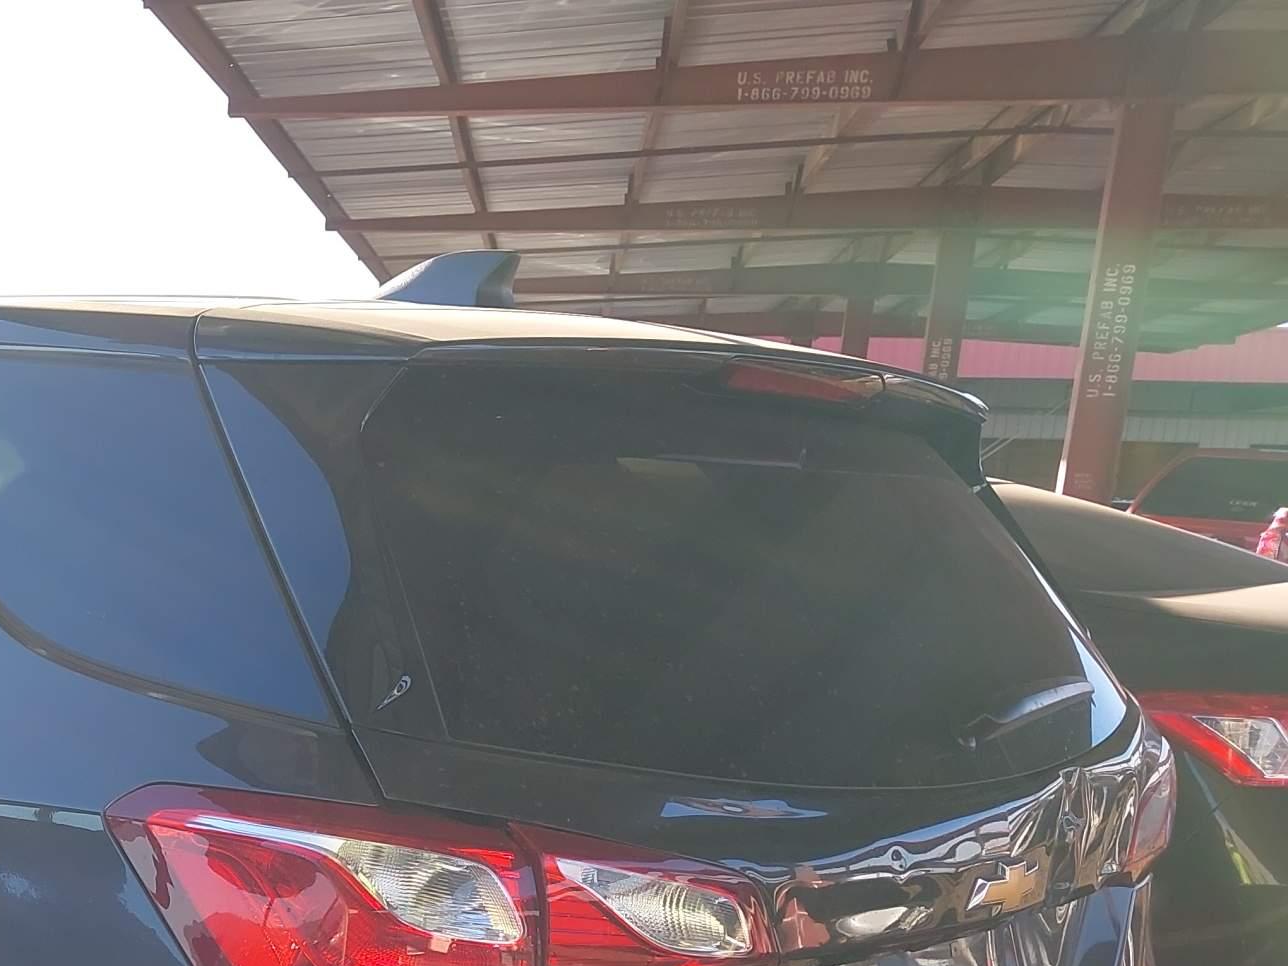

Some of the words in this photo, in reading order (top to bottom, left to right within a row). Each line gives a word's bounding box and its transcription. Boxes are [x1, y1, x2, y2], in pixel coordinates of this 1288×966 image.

[737, 71, 767, 85] U.S.
[775, 70, 837, 85] PREFAB
[844, 69, 873, 83] INC.
[1103, 263, 1121, 292] INC.
[1091, 300, 1115, 360] PREFAB
[1085, 369, 1104, 398] U.S.
